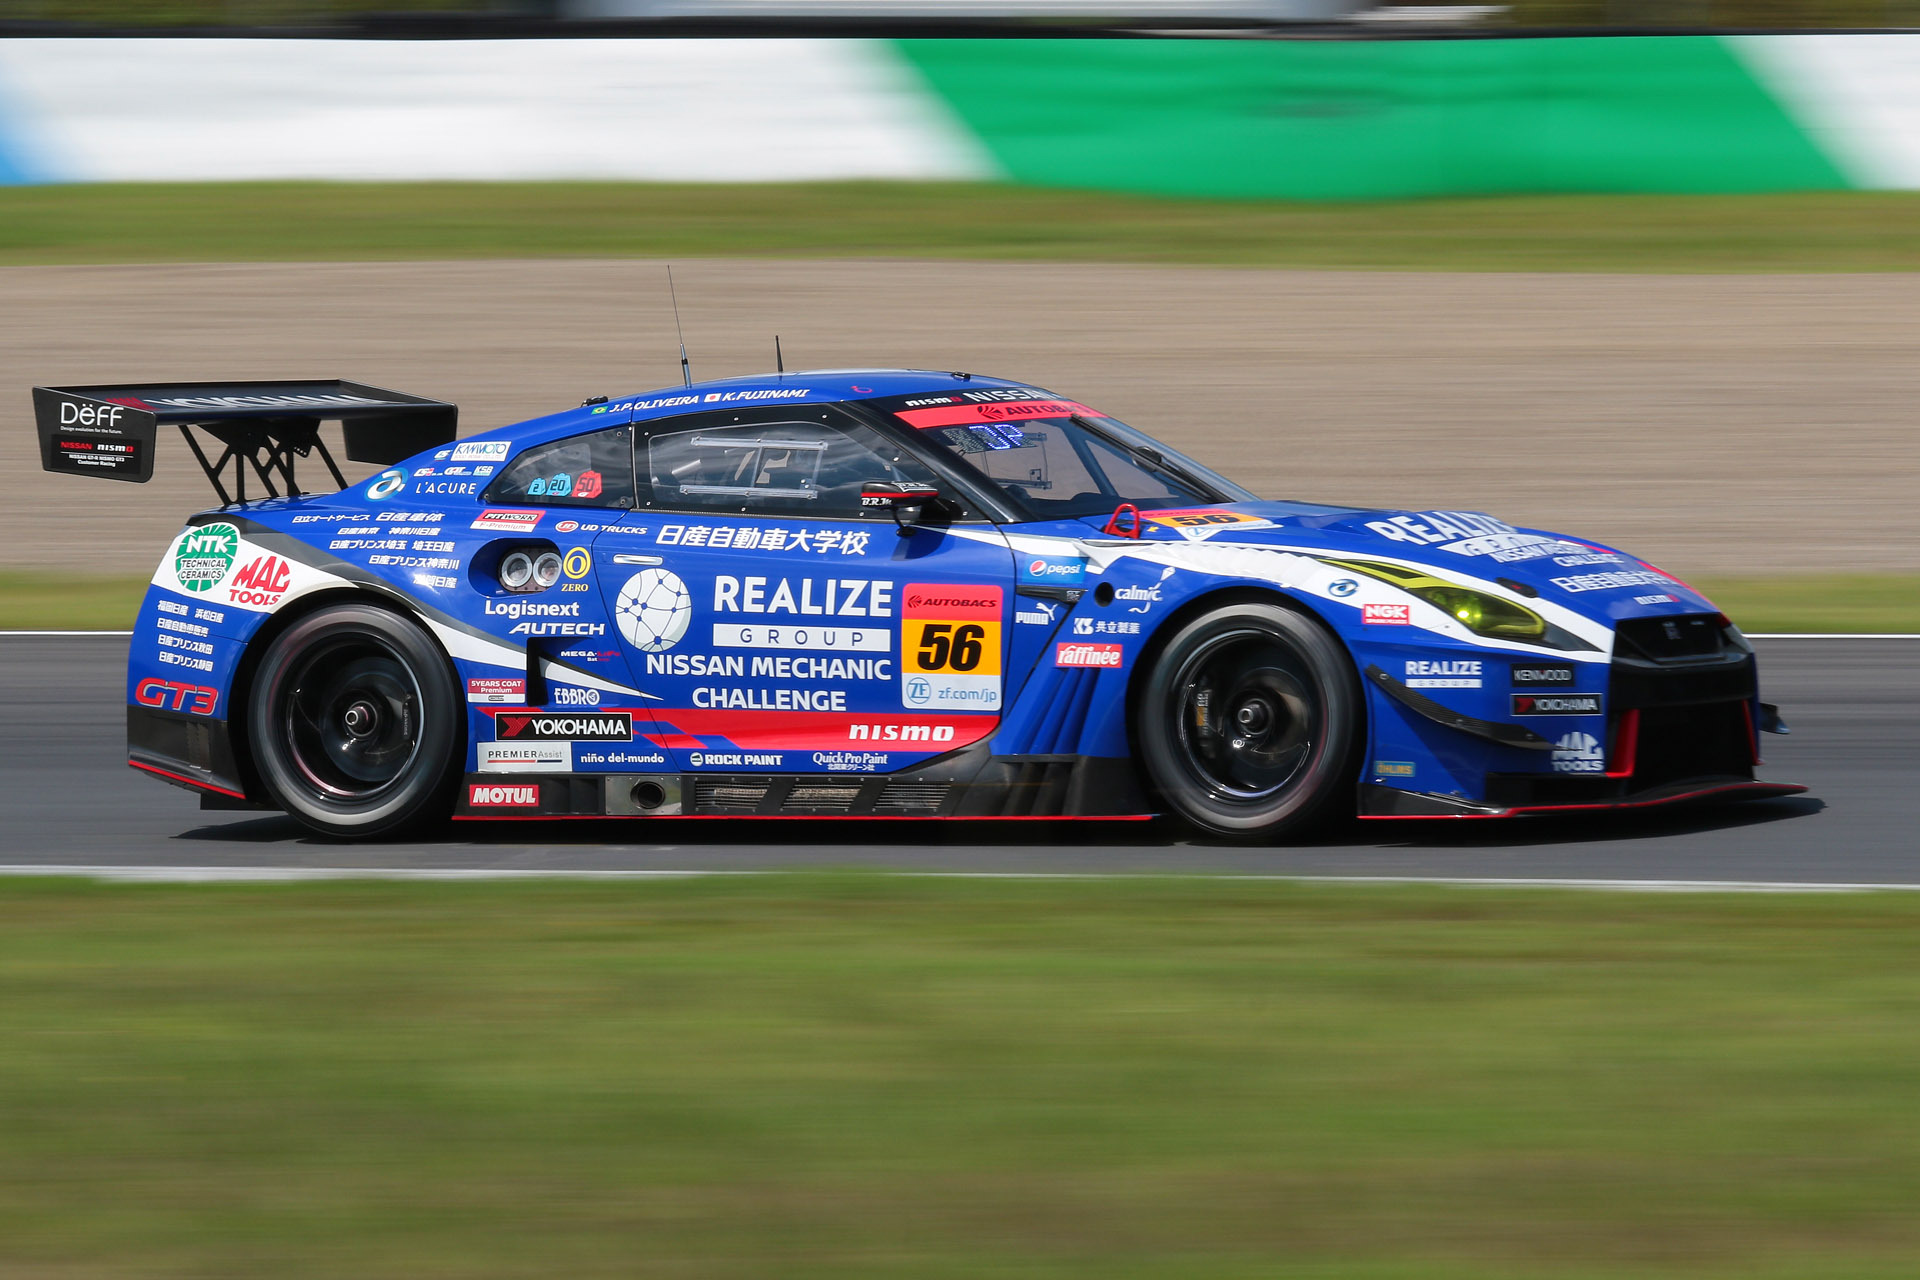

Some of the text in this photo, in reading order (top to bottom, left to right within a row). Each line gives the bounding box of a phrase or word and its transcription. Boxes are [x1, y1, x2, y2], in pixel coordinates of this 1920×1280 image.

[609, 389, 810, 412] J.P.OLIVEIRA K.FUJINAMI
[60, 442, 134, 453] NISSAN nismo
[100, 460, 116, 468] Racing
[533, 484, 540, 492] 2
[550, 480, 566, 490] 20
[577, 478, 595, 492] 50
[375, 512, 445, 522] 日産車体
[1171, 514, 1240, 526] 56
[580, 524, 599, 532] UD
[601, 525, 648, 535] TRUCKS
[186, 535, 232, 553] NTK
[656, 524, 870, 556] 日産自動車大学校
[181, 559, 226, 568] TECHNICAL
[1046, 564, 1080, 576] pepsi
[180, 570, 222, 579] CERAMICS
[232, 556, 290, 593] MAC
[561, 584, 589, 592] ZERO
[229, 588, 281, 606] TOOLS
[714, 575, 894, 618] REALIZE
[923, 598, 998, 608] AUTOBACS
[485, 600, 580, 620] Logisnext
[1365, 605, 1408, 619] NGK
[508, 622, 606, 636] AUTECH
[740, 628, 864, 647] GROUP
[917, 624, 985, 672] 56
[1057, 645, 1121, 666] raffinée
[646, 654, 892, 681] NISSAN MECHANIC
[1405, 660, 1482, 676] REALIZE
[1514, 670, 1572, 680] KENWOOD
[136, 677, 218, 716] GT3
[554, 688, 600, 706] EBBRO
[908, 682, 998, 702] ZF zf.com/jp
[692, 687, 847, 712] CHALLENGE
[1533, 698, 1598, 711] YOKOHAMA
[532, 719, 626, 735] YOKOHAMA
[848, 724, 955, 742] nismo
[580, 752, 664, 764] niño del-mundo
[704, 754, 783, 766] ROCK PAINT
[812, 752, 888, 765] Quick Pro Paint
[1552, 760, 1604, 772] TOOLS
[472, 788, 536, 804] MOTUL
